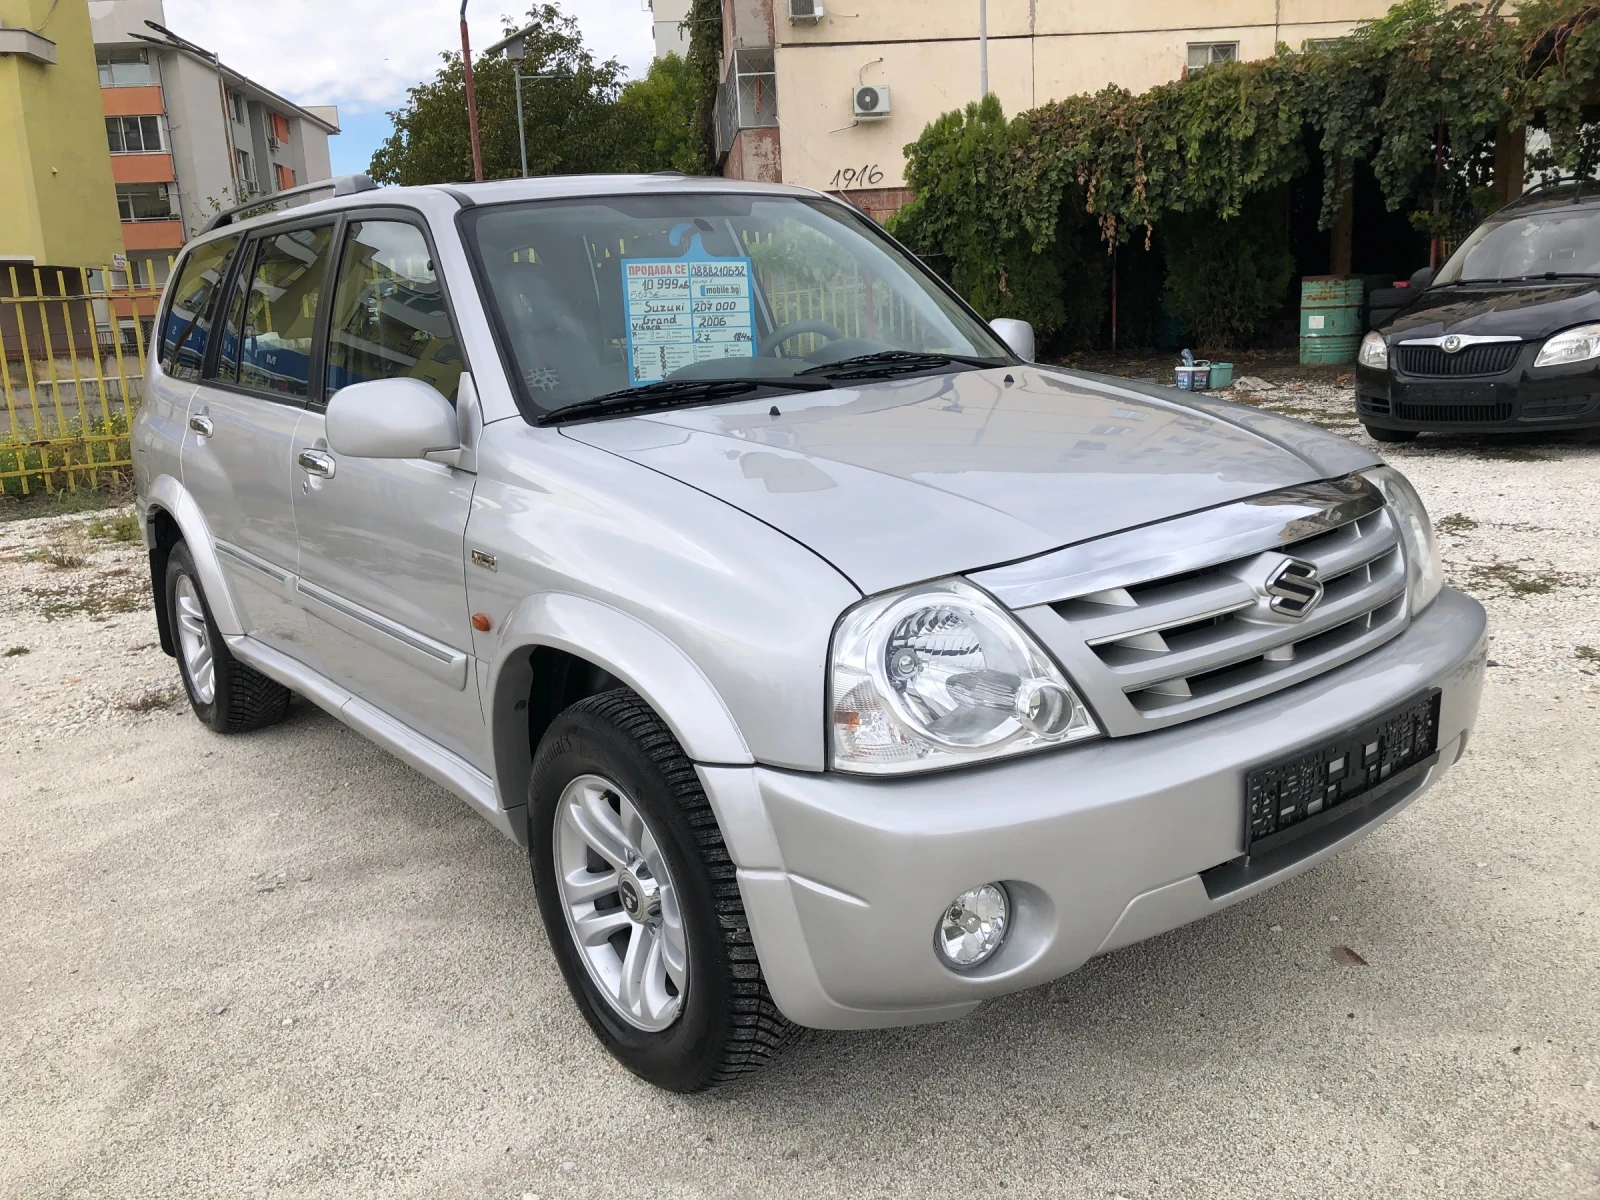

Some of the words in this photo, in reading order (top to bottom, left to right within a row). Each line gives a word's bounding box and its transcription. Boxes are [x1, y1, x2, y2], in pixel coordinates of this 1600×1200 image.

[830, 164, 884, 188] 1916
[628, 265, 673, 277] ПРОДАВА
[674, 264, 687, 275] СЕ
[642, 279, 654, 291] 10
[705, 284, 740, 295] mobile.bg
[644, 300, 685, 313] Suzuki
[693, 302, 713, 313] 207
[715, 301, 737, 312] 000
[642, 314, 678, 325] Grand
[698, 316, 727, 328] 2006
